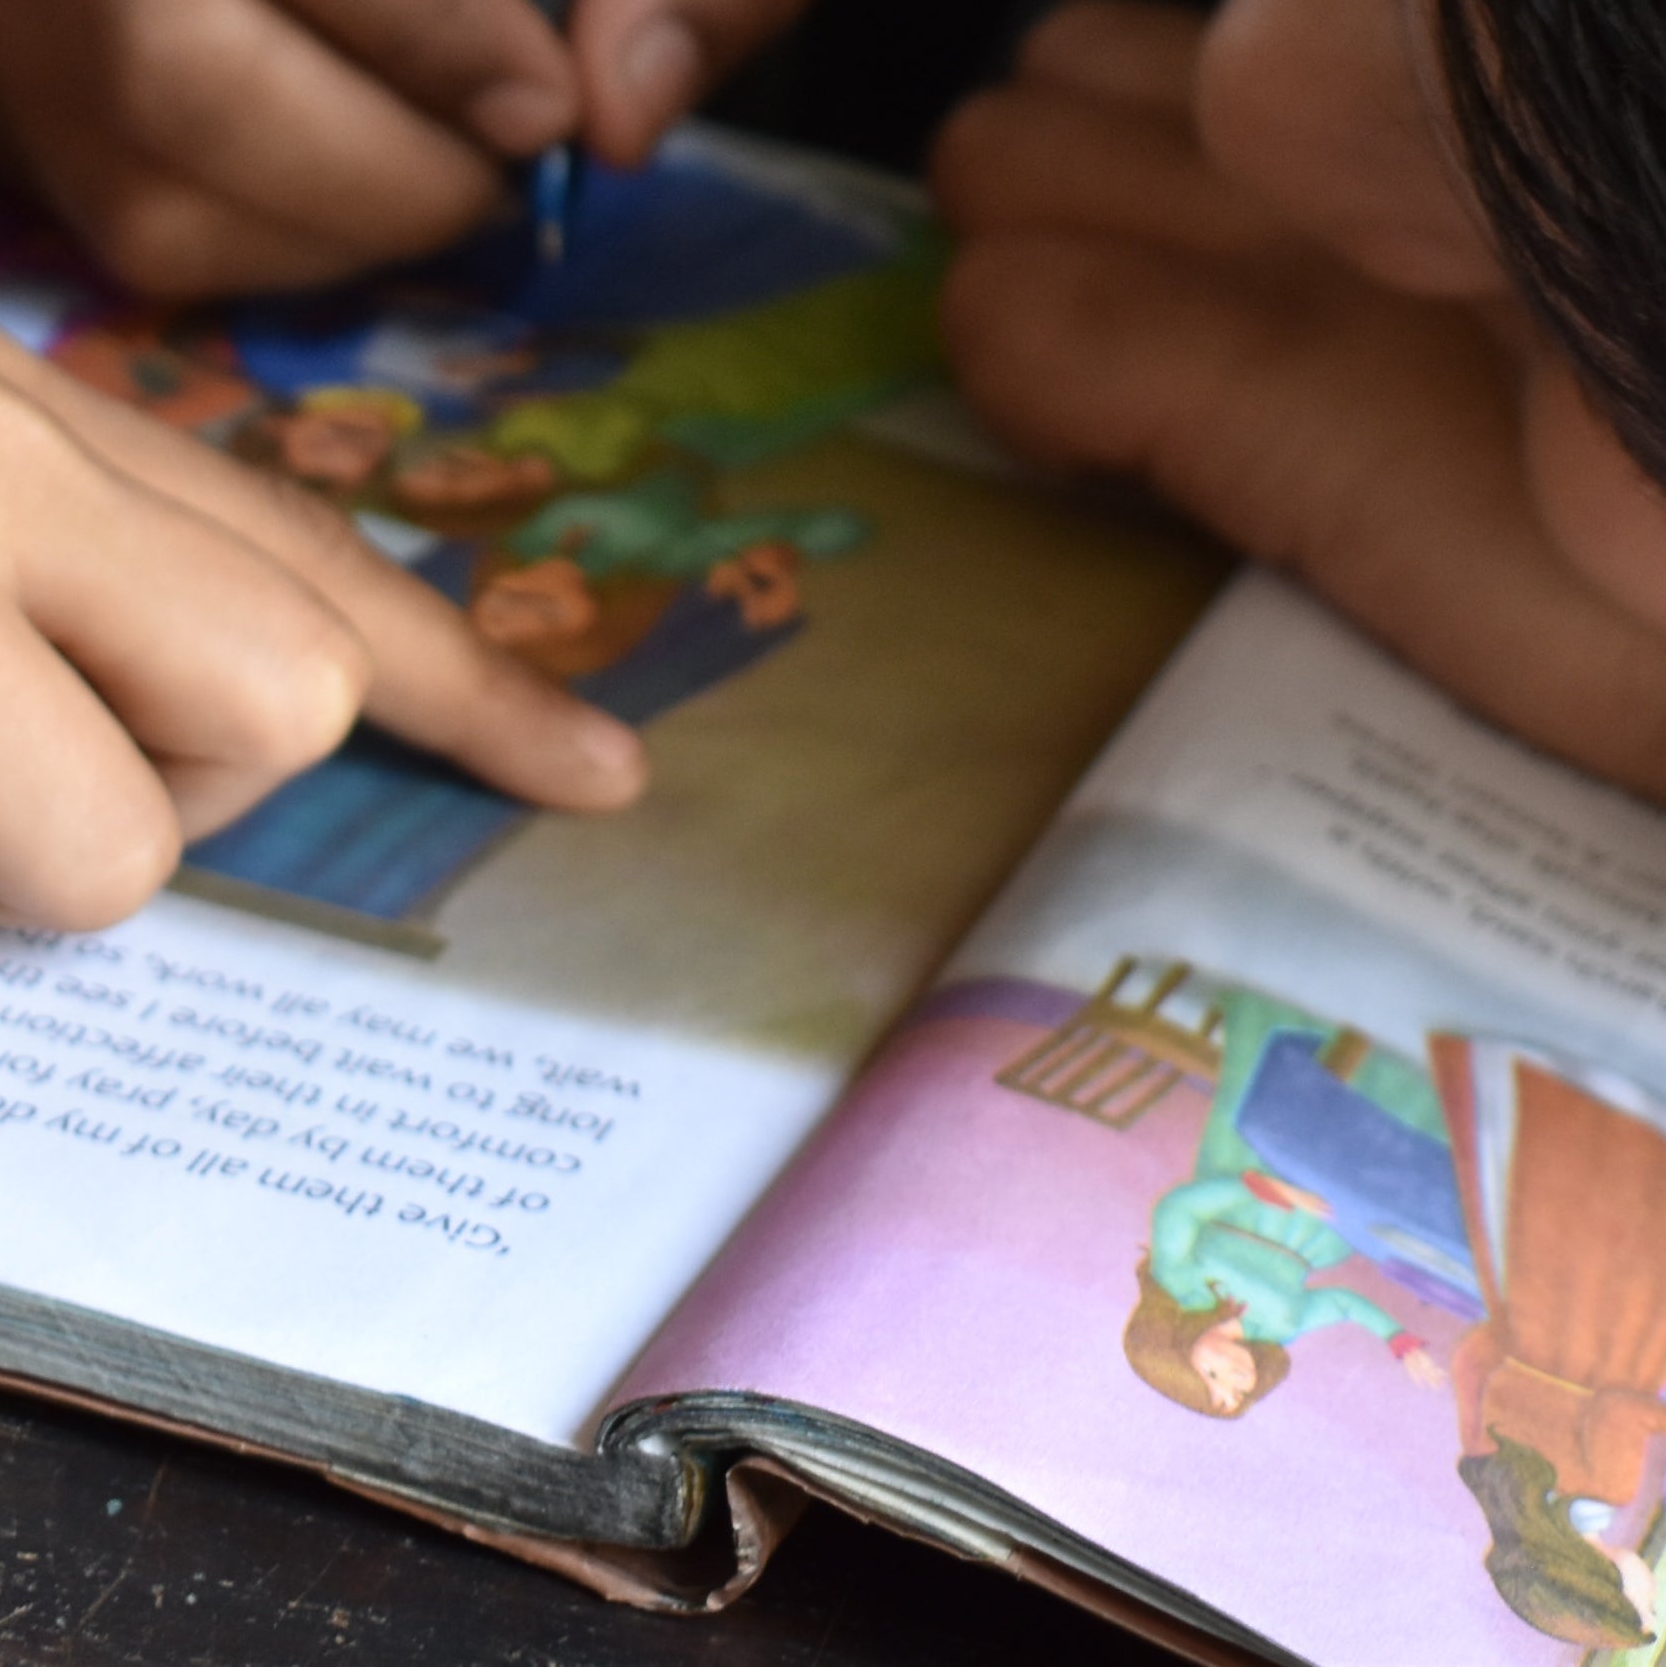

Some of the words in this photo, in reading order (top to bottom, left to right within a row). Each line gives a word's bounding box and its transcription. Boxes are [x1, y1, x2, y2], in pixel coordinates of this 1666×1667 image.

[54, 979, 130, 1011] see
[137, 999, 160, 1022] I
[167, 1008, 324, 1066] before
[214, 1064, 323, 1107] their
[332, 1048, 433, 1092] wait
[65, 1069, 178, 1111] pray
[332, 1093, 379, 1124] in
[444, 1082, 496, 1113] to
[43, 1110, 122, 1145] my
[188, 1096, 281, 1140] day,
[504, 1093, 615, 1143] long
[119, 1133, 183, 1158] of
[287, 1127, 350, 1163] by
[387, 1109, 583, 1175] comfort
[184, 1148, 250, 1178] all
[358, 1146, 486, 1199] them
[256, 1167, 385, 1218] them
[489, 1186, 552, 1213] of
